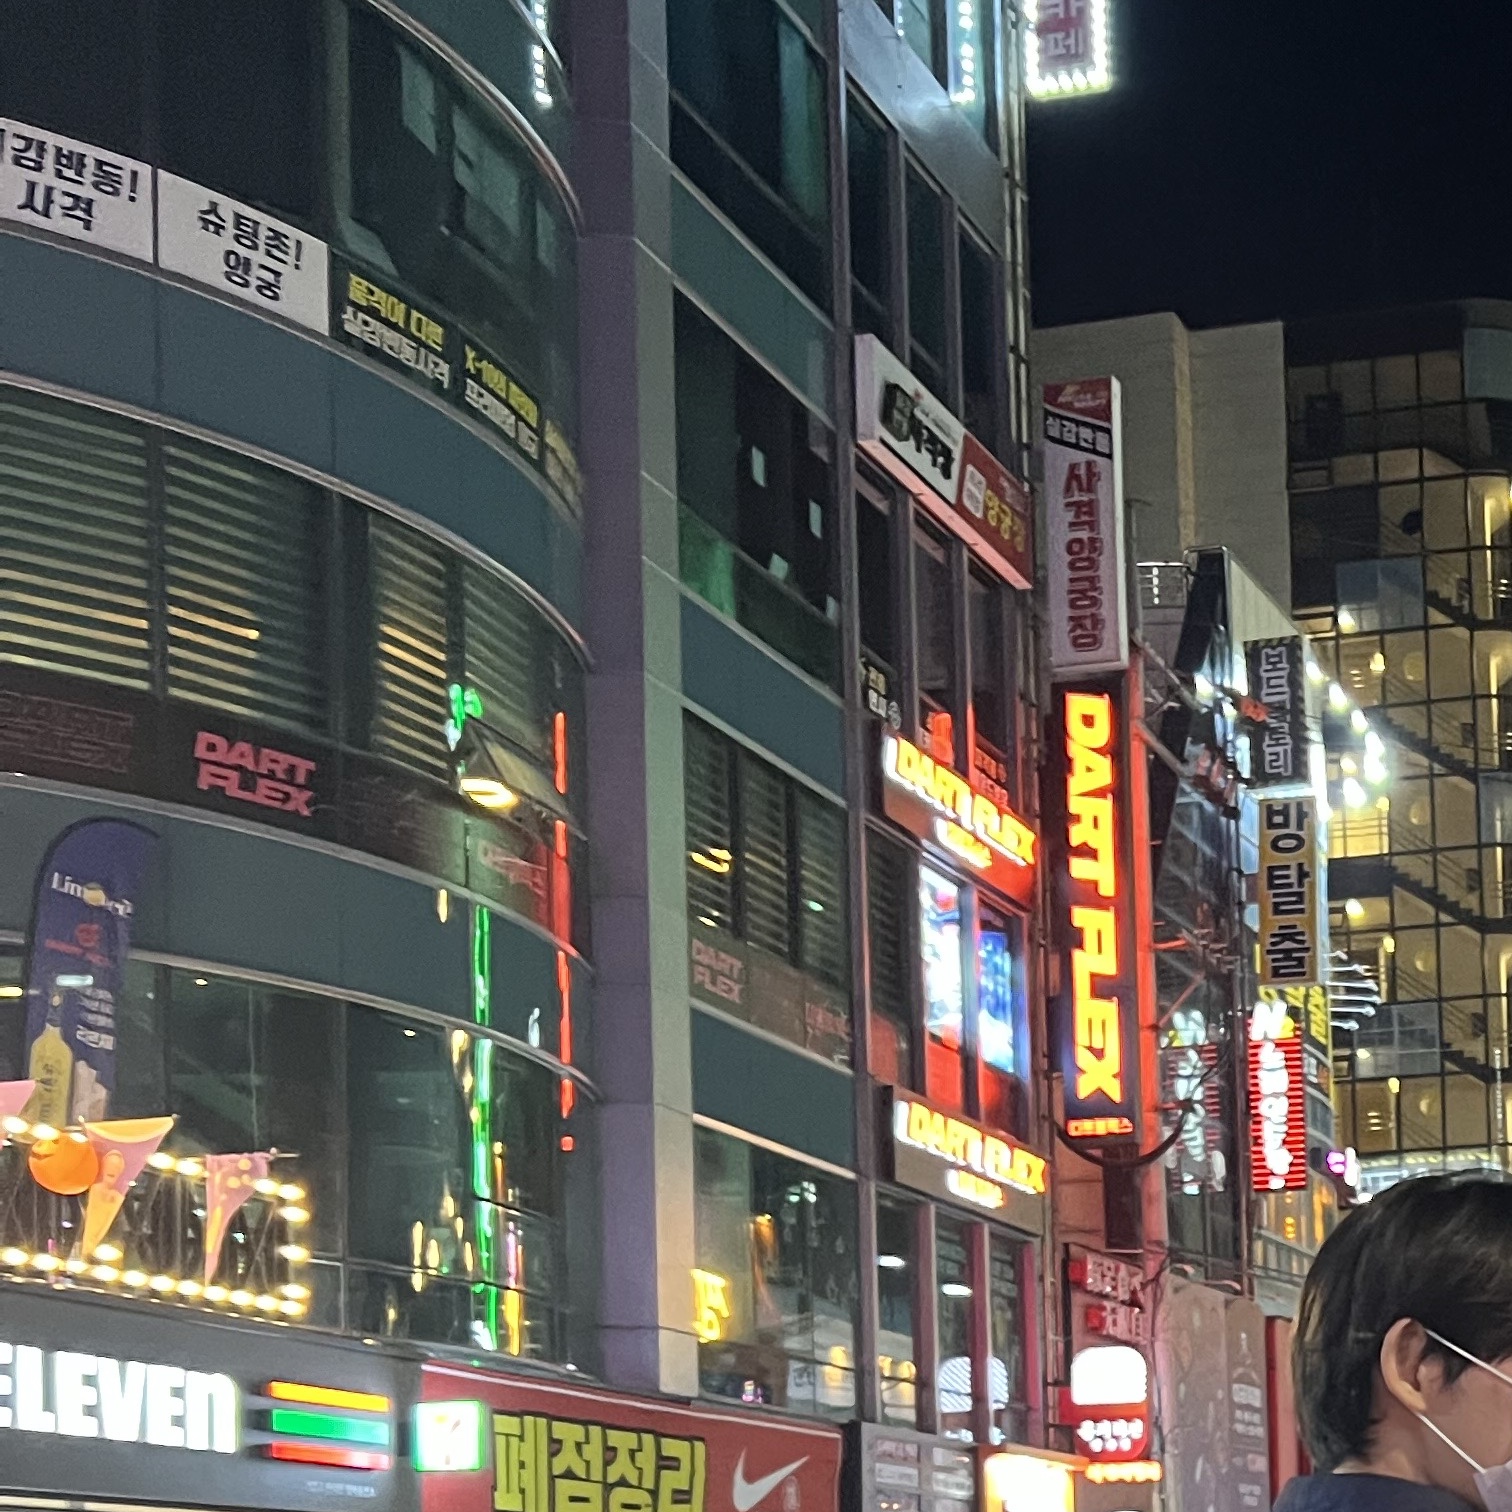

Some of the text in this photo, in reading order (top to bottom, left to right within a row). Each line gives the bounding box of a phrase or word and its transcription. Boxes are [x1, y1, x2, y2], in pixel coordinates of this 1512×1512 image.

[0, 128, 138, 202] 감반동!
[17, 179, 95, 231] 사격
[197, 200, 302, 271] 슈팅존!
[223, 249, 283, 302] 양궁
[194, 731, 316, 786] DART
[197, 763, 314, 817] FLEX
[1065, 692, 1122, 1104] DART FLEX
[1264, 802, 1311, 981] 방탈출
[900, 1100, 984, 1173] DART
